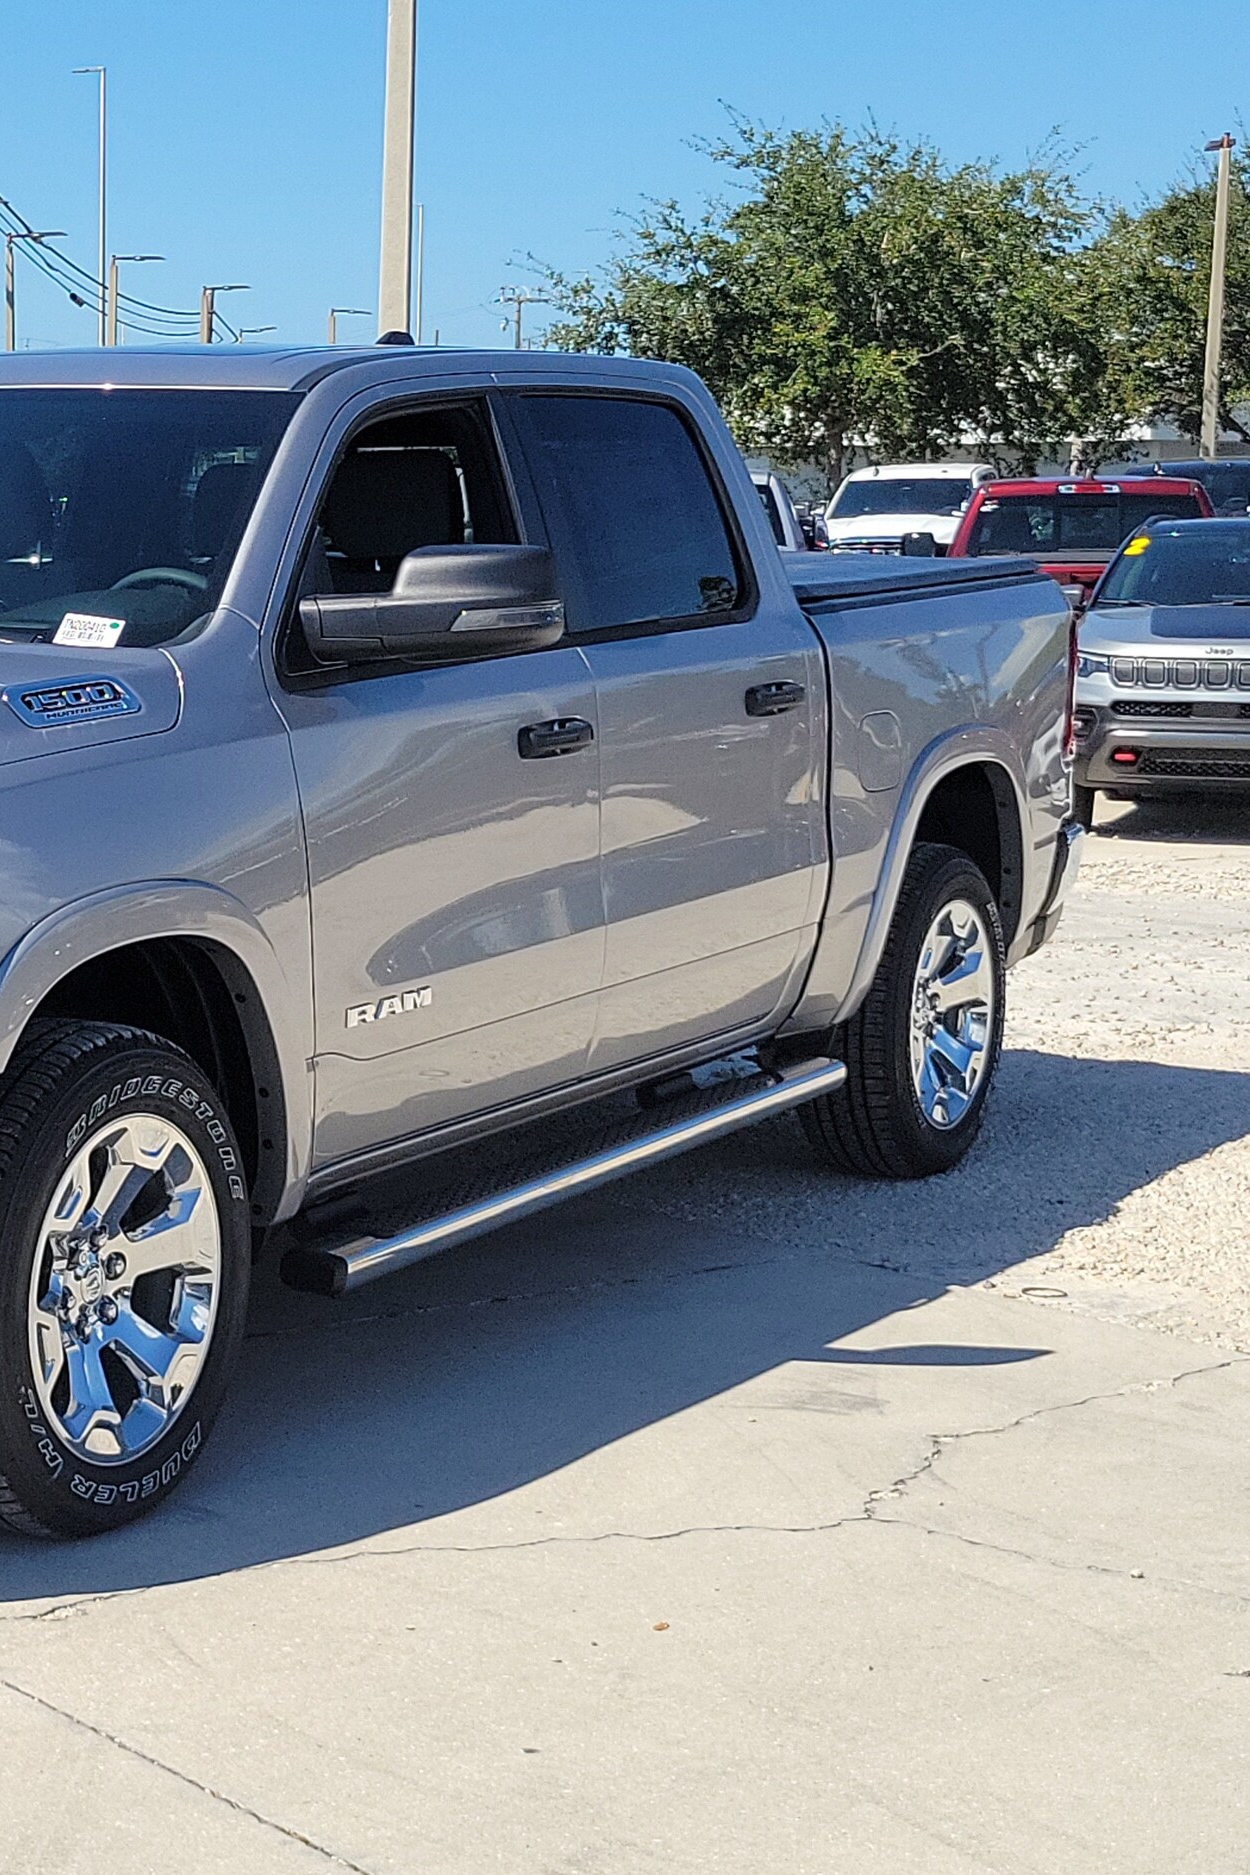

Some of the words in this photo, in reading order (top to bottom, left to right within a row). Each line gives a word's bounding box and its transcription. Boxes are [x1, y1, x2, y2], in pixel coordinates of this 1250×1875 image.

[1205, 646, 1234, 656] Jeep
[24, 684, 114, 712] 1500
[345, 985, 432, 1029] RAM
[65, 1075, 245, 1200] BRIDGESTONE
[69, 1421, 201, 1505] DUELER
